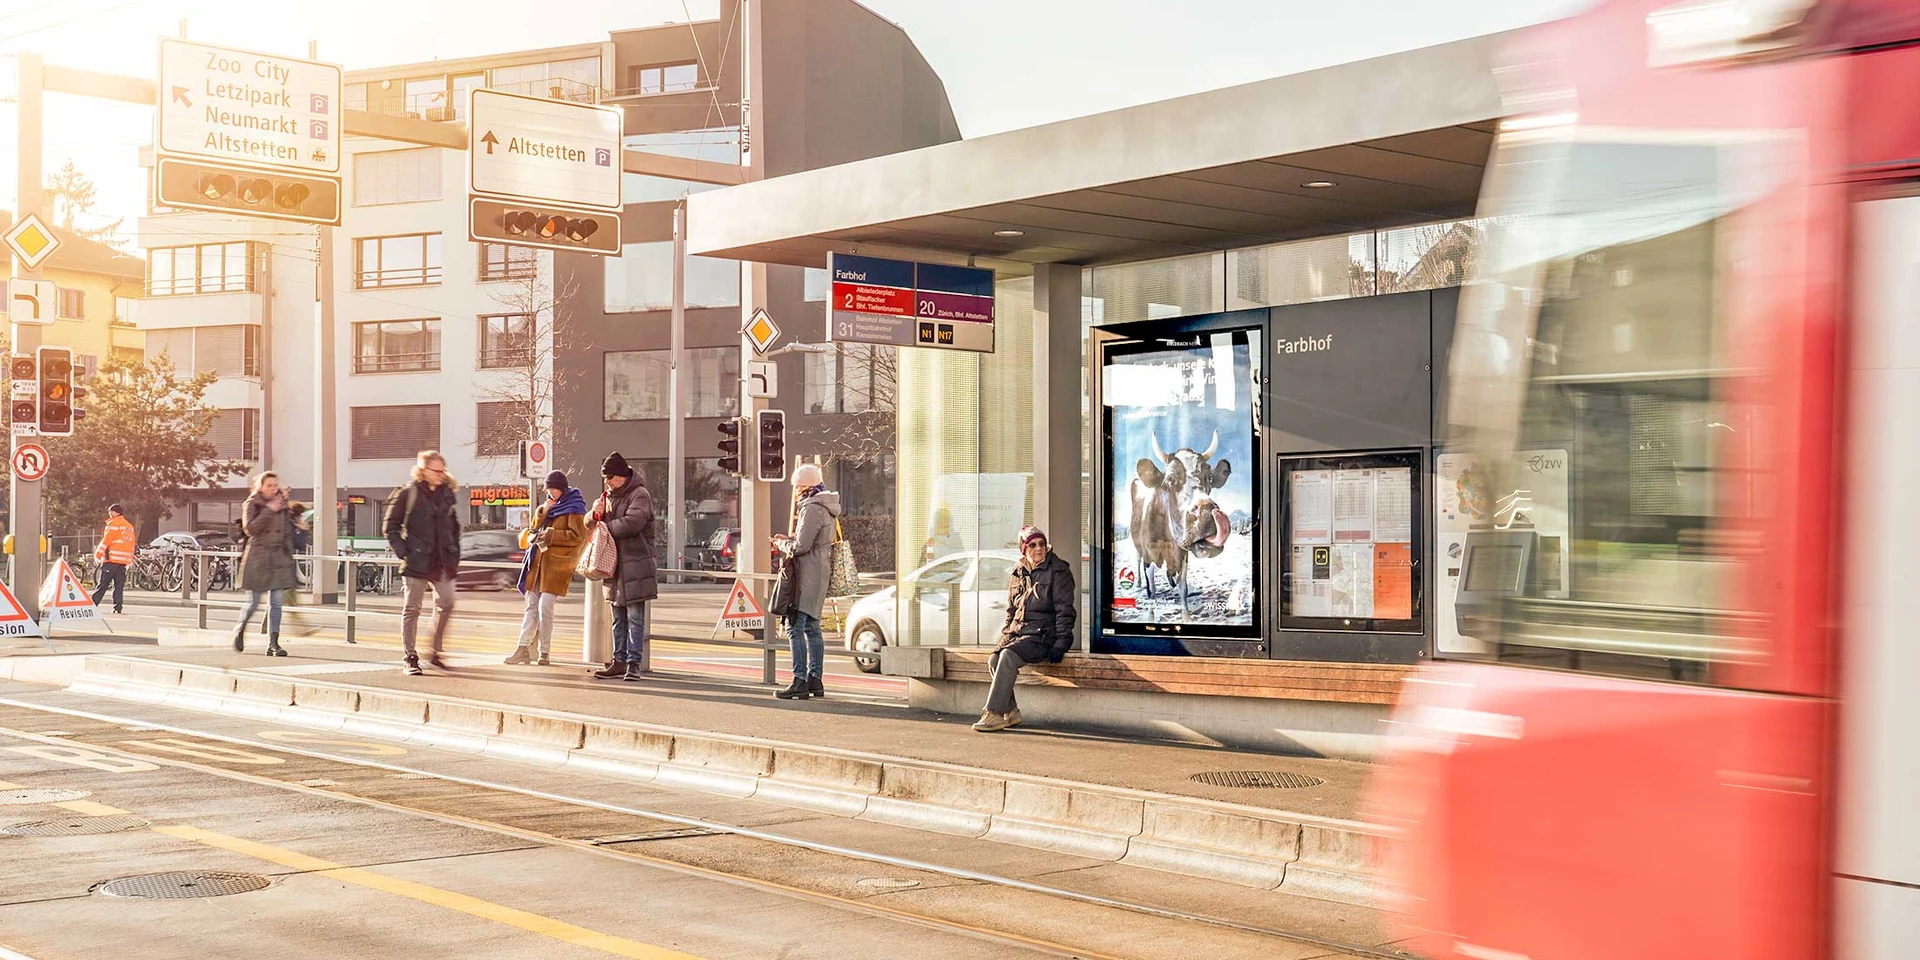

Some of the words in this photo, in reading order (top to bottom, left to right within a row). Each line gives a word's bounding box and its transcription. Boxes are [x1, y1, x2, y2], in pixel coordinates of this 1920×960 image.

[205, 52, 241, 74] Zoo
[255, 60, 290, 86] City
[205, 78, 291, 108] Letzipark
[205, 105, 298, 135] Neumarkt
[204, 131, 298, 161] Altstetten
[508, 136, 587, 163] Altstetten
[836, 269, 867, 281] Farbhof
[845, 293, 854, 309] 2
[919, 299, 936, 316] 20
[838, 321, 853, 338] 31
[921, 328, 932, 339] N1
[938, 330, 953, 340] N17
[1276, 334, 1333, 355] Farbhof
[1544, 459, 1562, 469] ZVV
[60, 608, 94, 619] Revision
